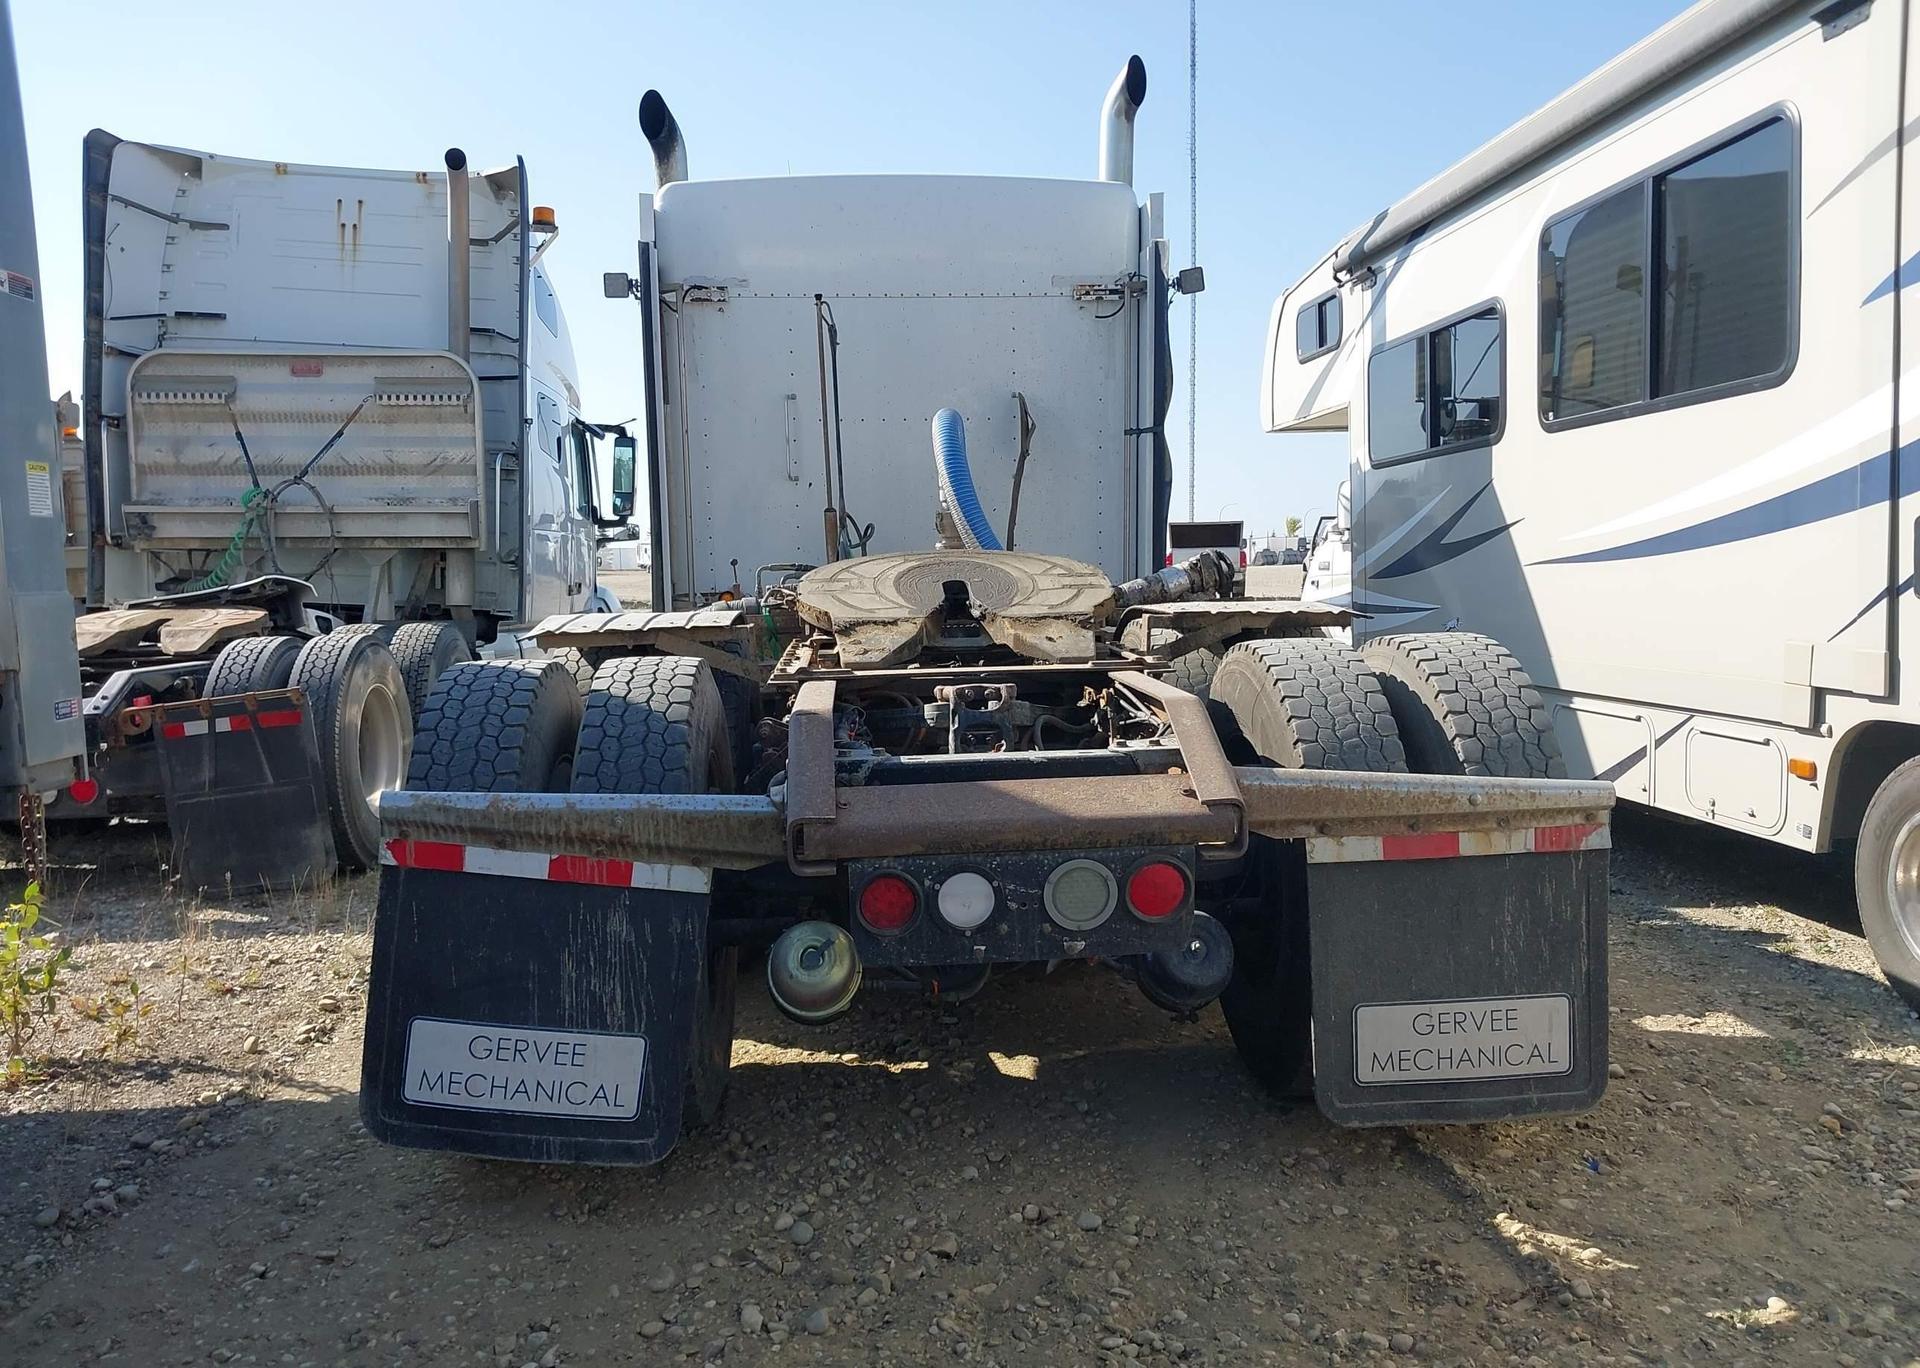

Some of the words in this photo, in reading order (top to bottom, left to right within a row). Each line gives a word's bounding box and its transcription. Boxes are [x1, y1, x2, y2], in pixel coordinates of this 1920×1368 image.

[28, 464, 47, 472] CAUTION
[1412, 1008, 1518, 1036] GERVEE
[468, 1035, 587, 1067] GERVEE
[1371, 1042, 1558, 1073] MECHANICAL
[418, 1069, 625, 1108] MECHANICAL
